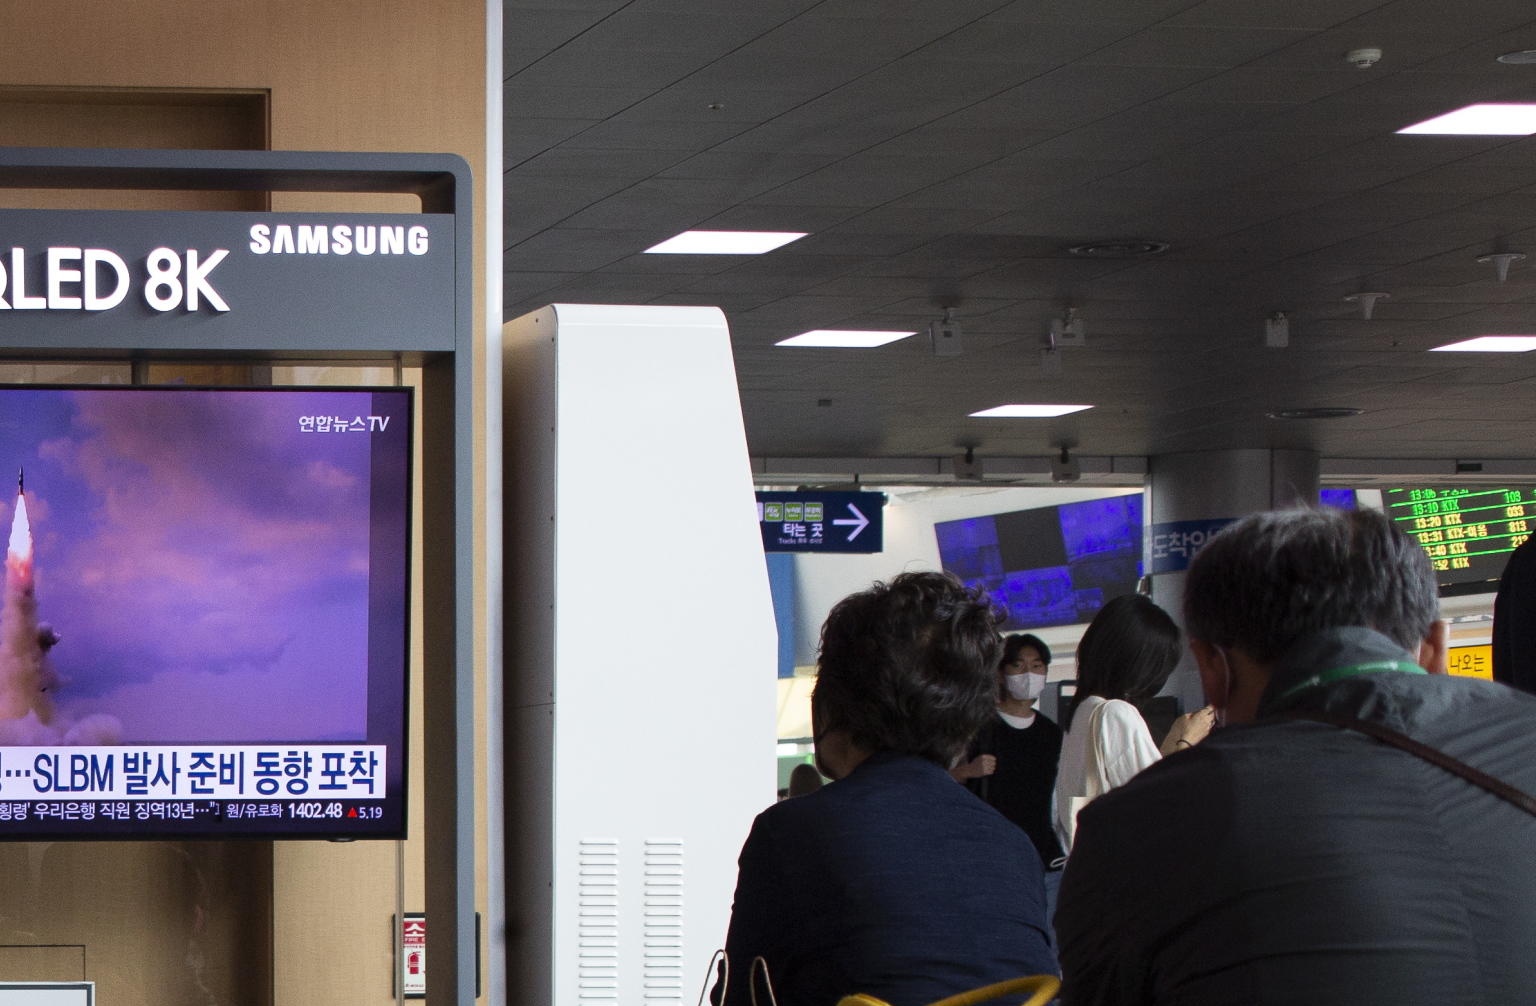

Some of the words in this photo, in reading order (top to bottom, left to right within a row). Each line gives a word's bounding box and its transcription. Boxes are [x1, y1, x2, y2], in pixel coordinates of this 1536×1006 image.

[249, 224, 430, 256] SAMSUNG
[144, 247, 232, 313] 8K
[1442, 499, 1460, 512] KTX
[1416, 515, 1442, 530] 13:20
[1444, 513, 1462, 526] KTX
[783, 523, 806, 538] 타는
[810, 523, 823, 538] 곳
[1423, 544, 1447, 558] 3:40
[1449, 542, 1468, 555] KTX
[1452, 556, 1470, 570] KTX
[1450, 653, 1485, 674] 나오는
[122, 751, 182, 796] 발사
[186, 751, 246, 796] 준비
[252, 751, 313, 796] 동향
[317, 750, 379, 796] 포착
[33, 802, 96, 820] 우리은행
[100, 802, 131, 820] 직원
[225, 802, 284, 820] 원/유로화
[288, 802, 343, 819] 1402.48
[358, 806, 384, 820] 5.19
